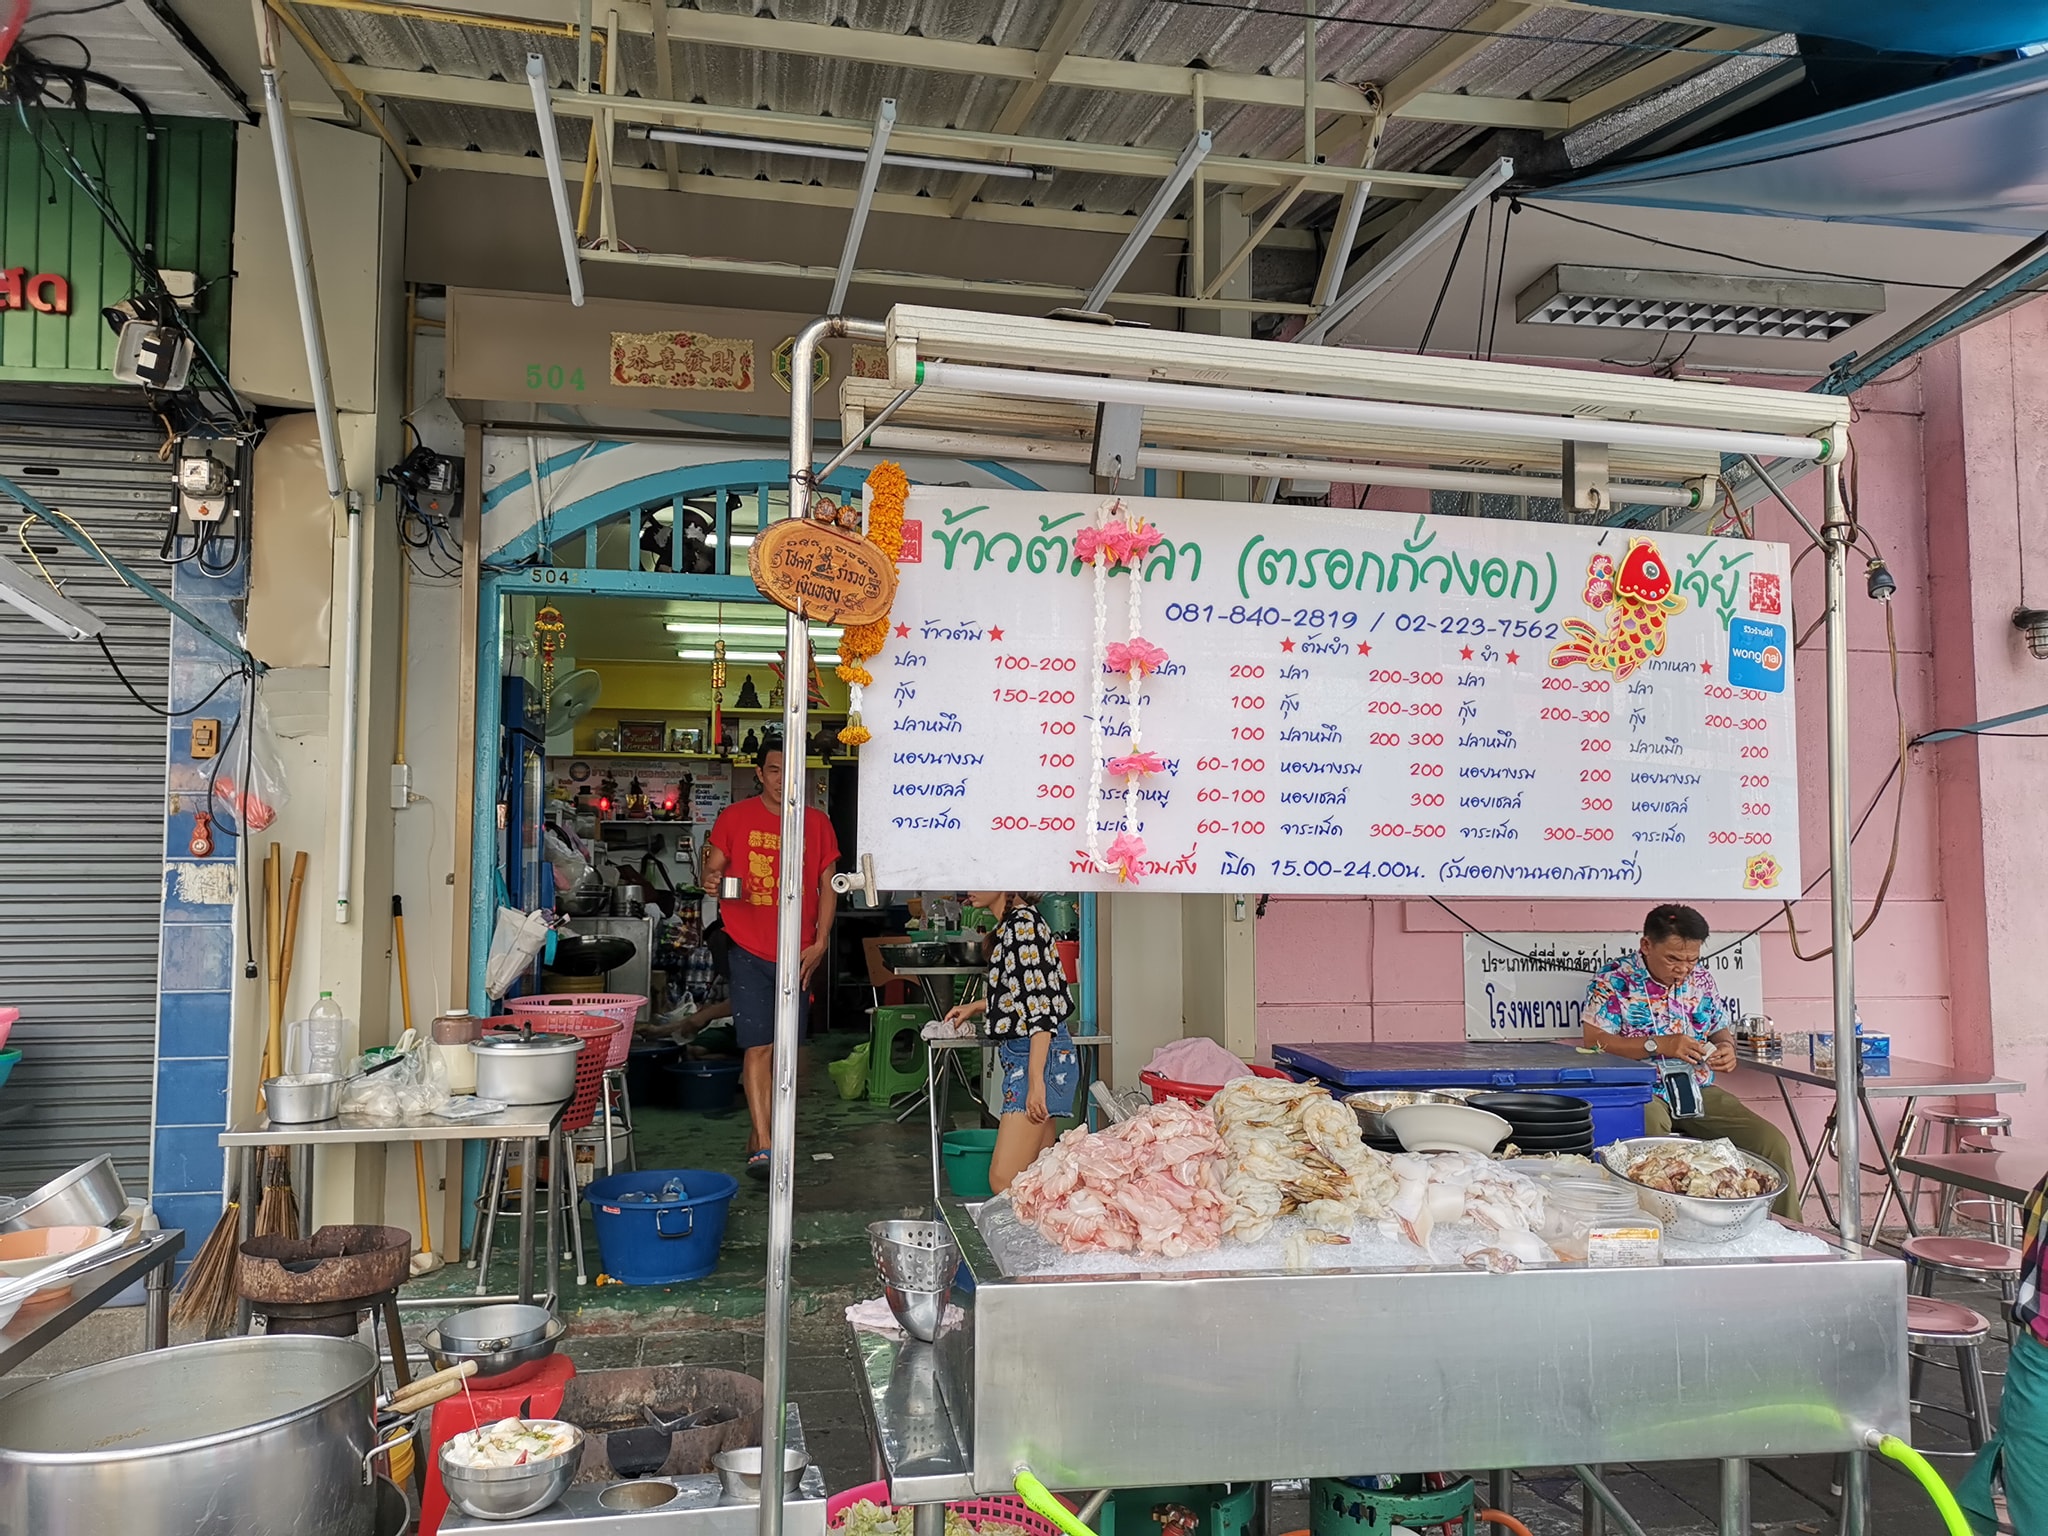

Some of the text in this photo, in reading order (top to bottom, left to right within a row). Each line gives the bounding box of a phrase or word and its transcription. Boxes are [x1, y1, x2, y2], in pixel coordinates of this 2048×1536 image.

[626, 344, 736, 376] 恭喜發財
[527, 364, 585, 392] 504
[1238, 515, 1558, 613] (ตรอกถั่วงอก)
[532, 569, 569, 585] 504
[920, 619, 983, 641] ข้าวต้ม
[1166, 603, 1357, 629] 081-840-2819
[1395, 614, 1558, 639] 02-223-7562
[1302, 633, 1349, 655] ต้มยำ
[1481, 645, 1498, 662] ยำ
[894, 651, 1076, 671] ปลา 100-200
[1649, 660, 1696, 672] เกาเหลา
[1733, 647, 1779, 664] wongnai
[1230, 665, 1264, 678] 200
[1280, 664, 1443, 685] ปลา 200-300
[1458, 672, 1610, 692] ปลา 200-300
[894, 681, 1075, 708] กุ้ง 150-200
[1628, 680, 1767, 702] ปลา 200-300
[1232, 696, 1265, 709] 100
[1280, 693, 1442, 720] กุ้ง 200-300
[1458, 700, 1610, 726] กุ้ง 200-300
[893, 712, 1075, 735] ปลาหมึก 100
[1629, 708, 1767, 732] กุ้ง 200-300
[1232, 727, 1264, 740] 100
[1280, 723, 1444, 746] ปลาหมึก 200 300
[1459, 730, 1611, 752] ปลาหมึก 200
[1630, 736, 1768, 758] ปลาหมึก 200
[893, 752, 1074, 767] หอยนางรม 100
[1197, 756, 1265, 772] 60-100
[1281, 762, 1443, 777] หอยนางรม 200
[1460, 767, 1611, 782] หอยนางรม 200
[1631, 773, 1769, 787] หอยนางรม 200
[893, 778, 1075, 798] หอยเชลล์ 300
[1197, 788, 1265, 803] 60-100
[1281, 787, 1444, 806] หอยเชลล์ 300
[1460, 791, 1612, 811] หอยเชลล์ 300
[1632, 797, 1689, 813] หอยเชลล์
[892, 807, 1075, 831] จาระเม็ด 300-500
[1197, 819, 1265, 834] 60-100
[1280, 815, 1446, 838] จาระเม็ด 300-500
[1460, 819, 1614, 841] จาระเม็ด 300-500
[1632, 823, 1772, 844] จาระเม็ด 300-500
[1221, 851, 1255, 876] เปิด
[1272, 860, 1425, 878] 15.00-24.00น.
[1439, 850, 1642, 885] (รับออกงานนอกสถานที่)
[1715, 956, 1729, 970] 10
[1485, 983, 1585, 1029] โรงพยาบา
